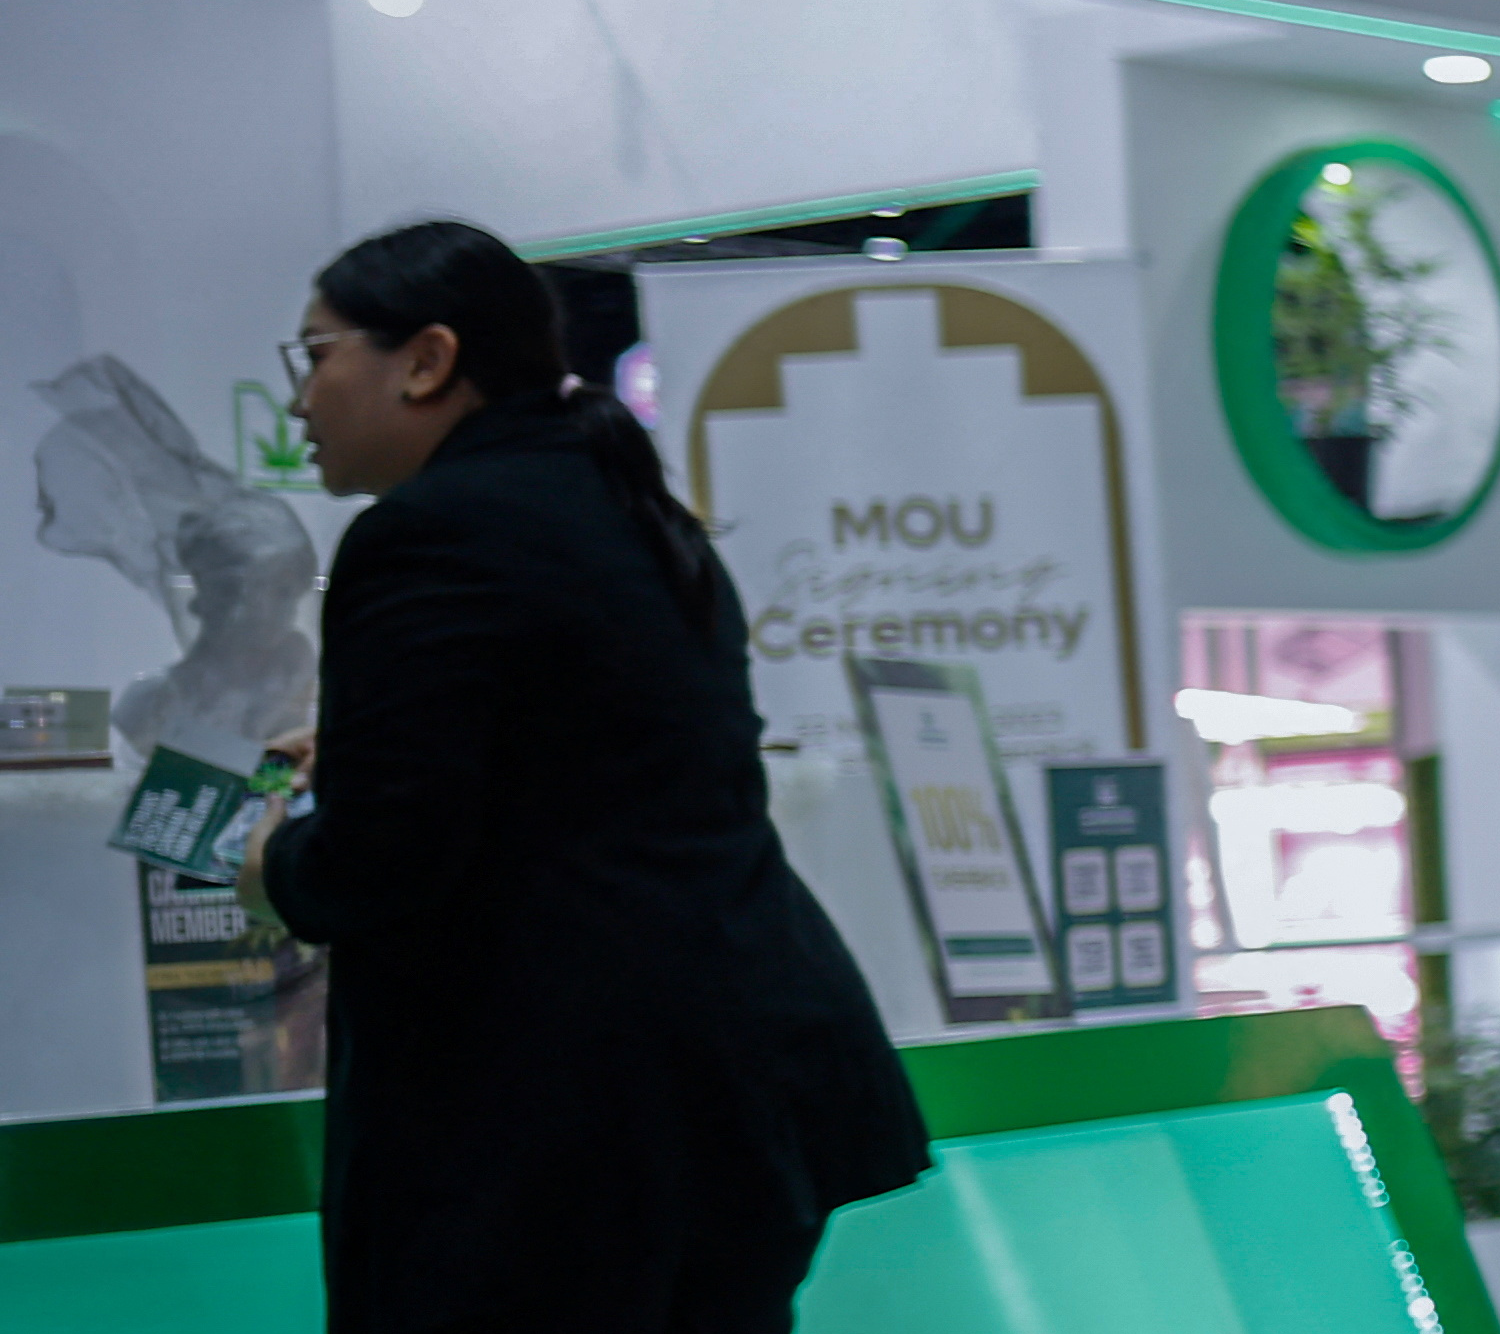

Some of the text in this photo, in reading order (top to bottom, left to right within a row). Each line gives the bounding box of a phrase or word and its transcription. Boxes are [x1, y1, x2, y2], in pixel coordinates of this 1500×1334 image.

[831, 496, 997, 551] MOU
[750, 606, 1089, 663] Ceremony
[150, 906, 246, 945] MEMBER
